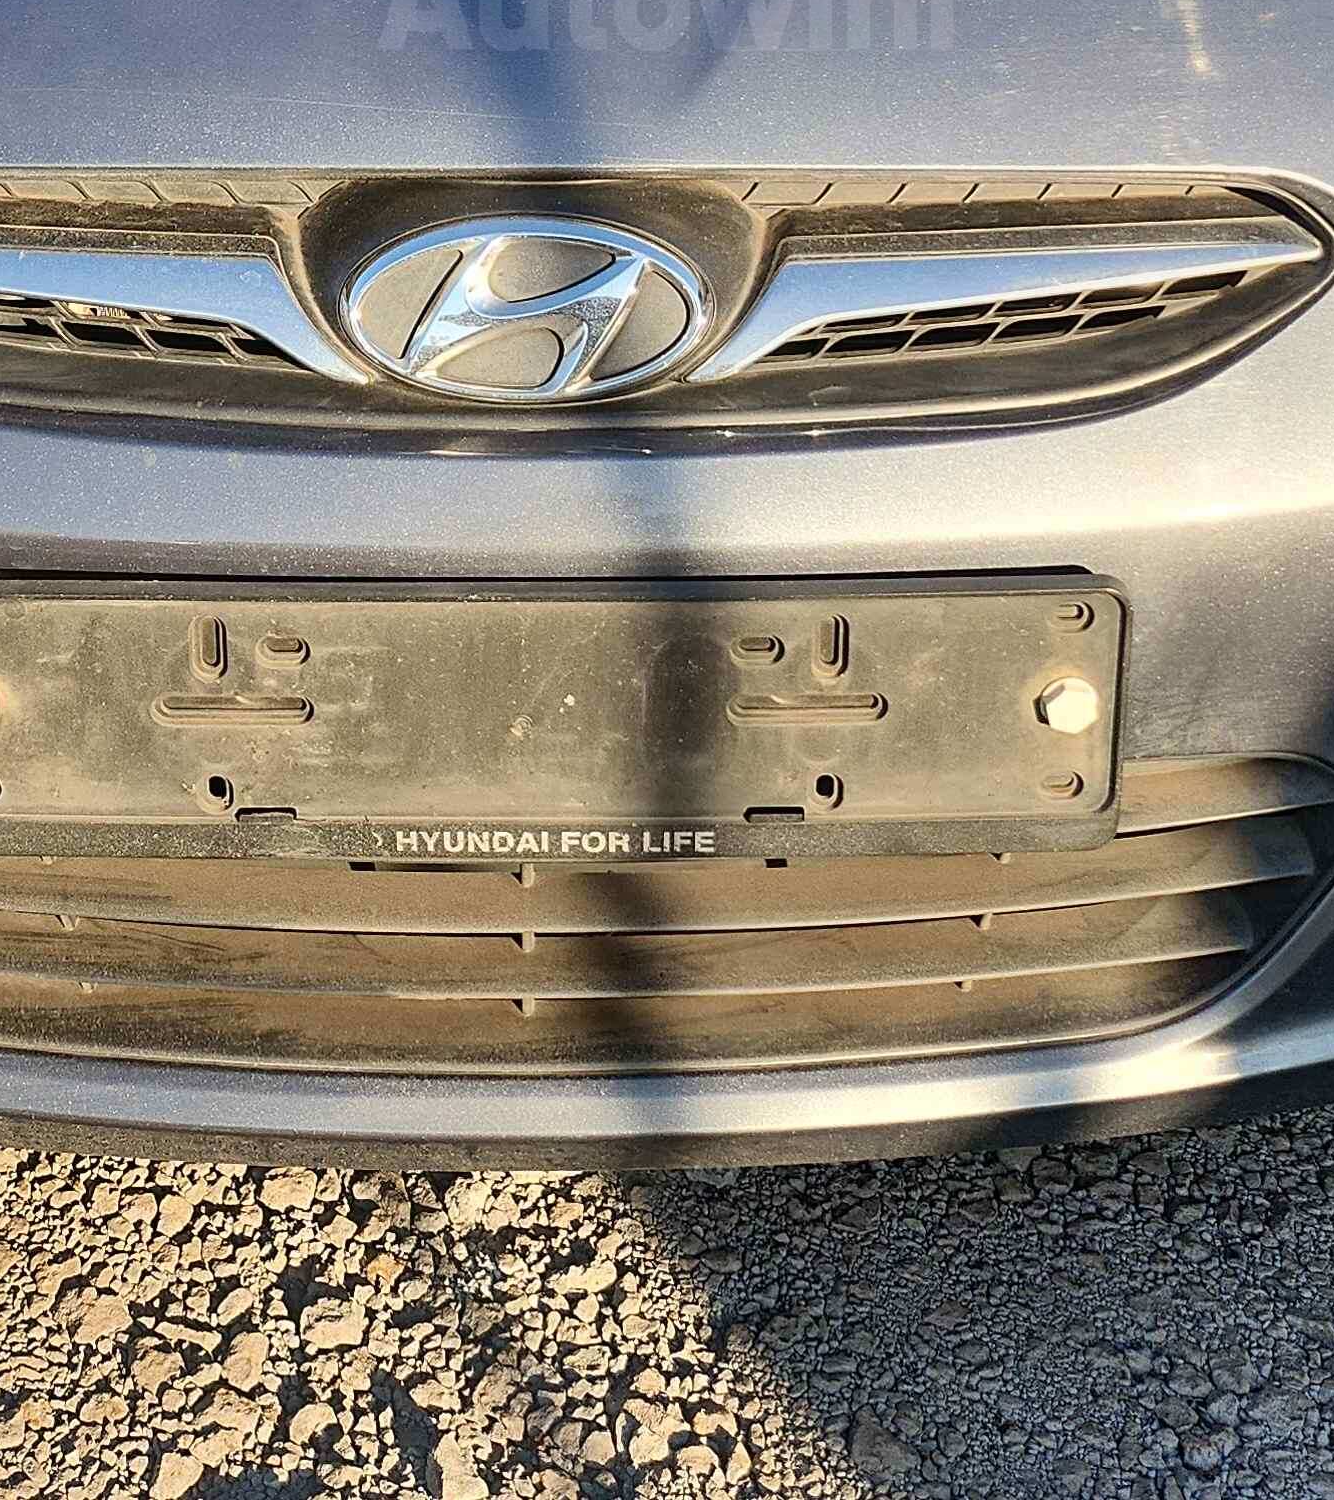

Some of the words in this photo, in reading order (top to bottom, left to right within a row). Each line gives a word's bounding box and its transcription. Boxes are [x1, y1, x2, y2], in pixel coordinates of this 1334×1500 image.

[395, 831, 549, 853] HYUNDAI
[561, 831, 630, 853] FOR
[642, 831, 716, 853] LIFE
